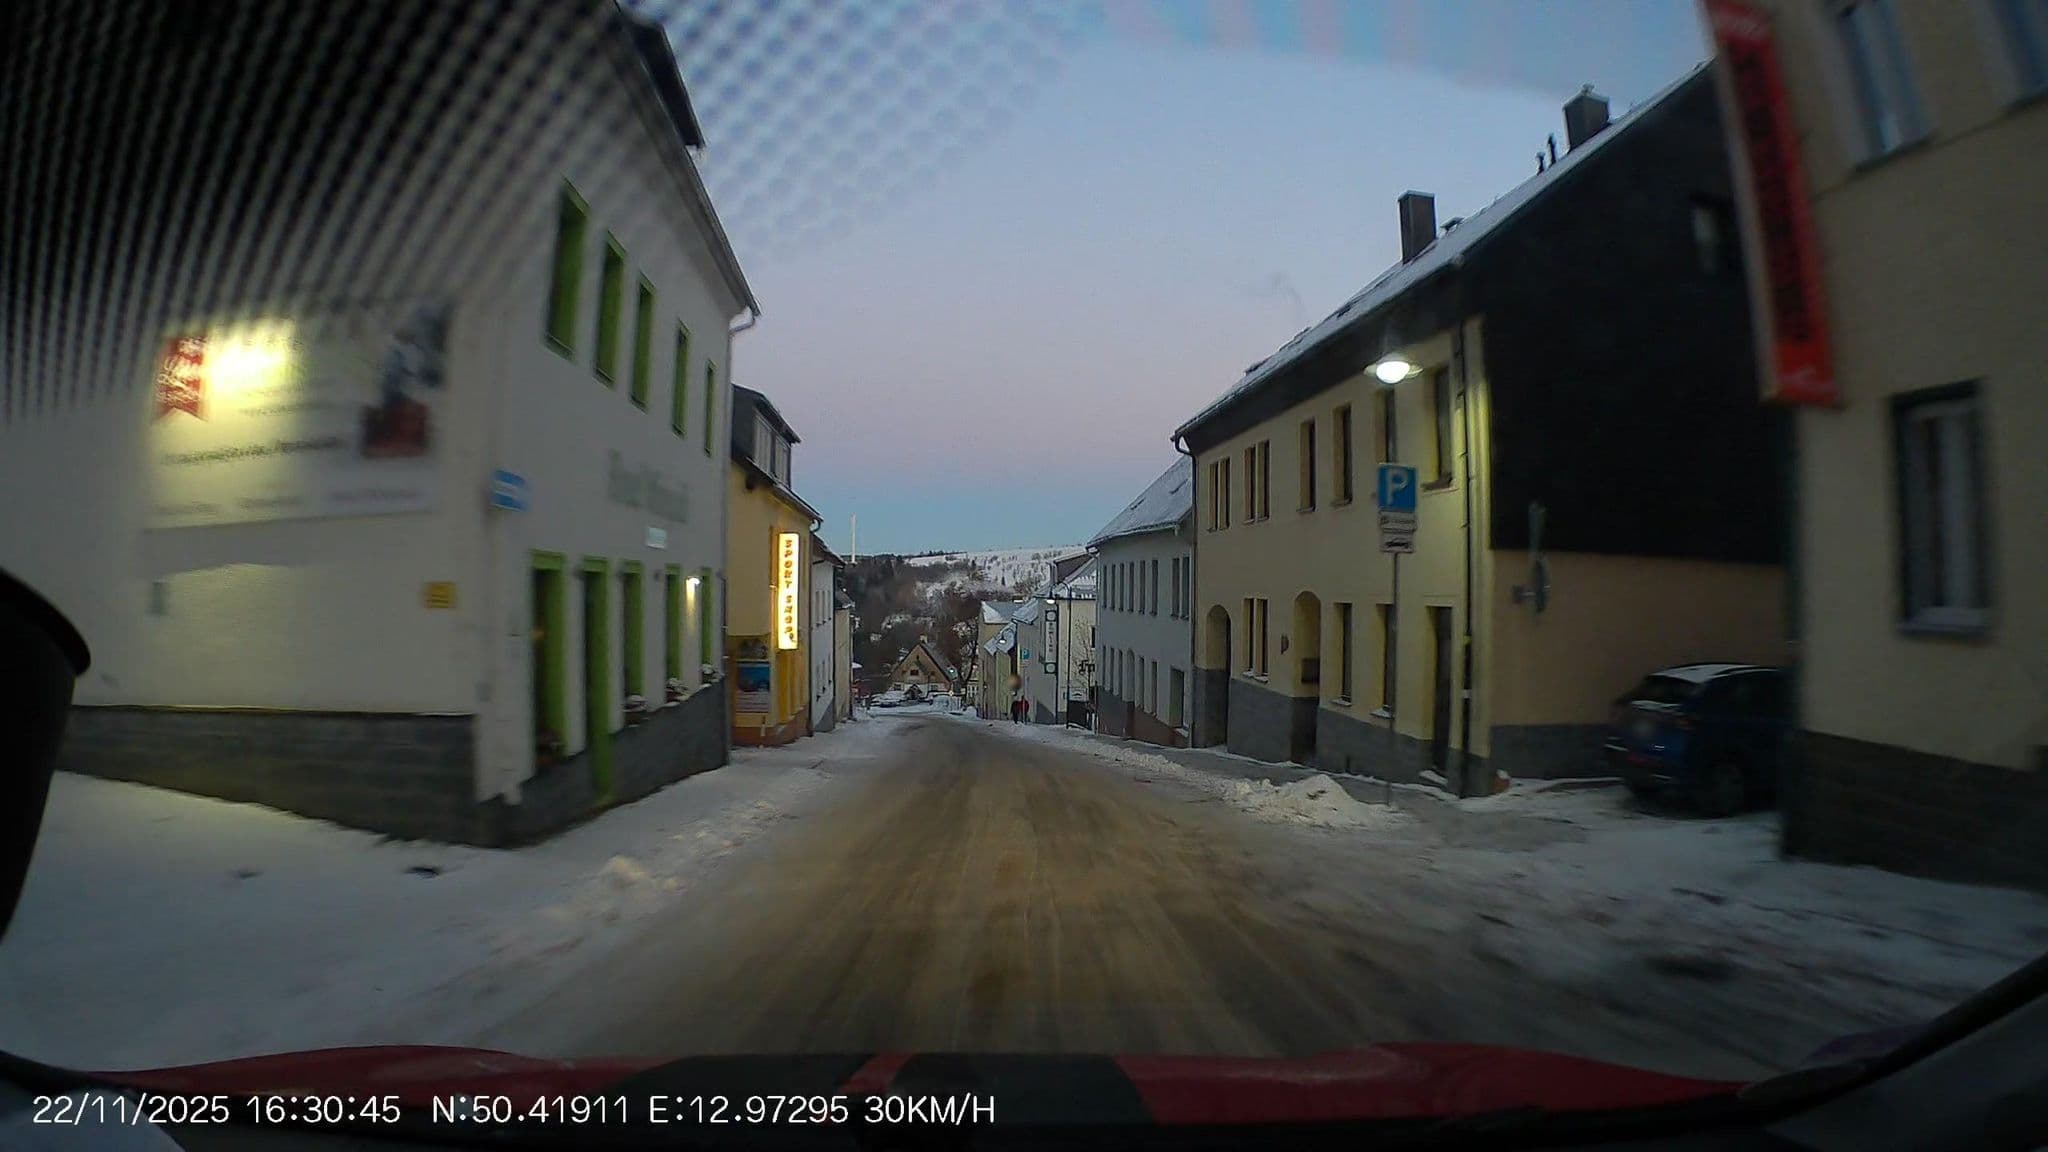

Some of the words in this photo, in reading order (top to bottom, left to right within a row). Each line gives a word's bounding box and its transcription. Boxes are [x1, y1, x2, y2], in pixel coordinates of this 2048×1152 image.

[1387, 468, 1408, 505] P
[783, 539, 793, 588] SPORT
[783, 595, 793, 633] SHOP
